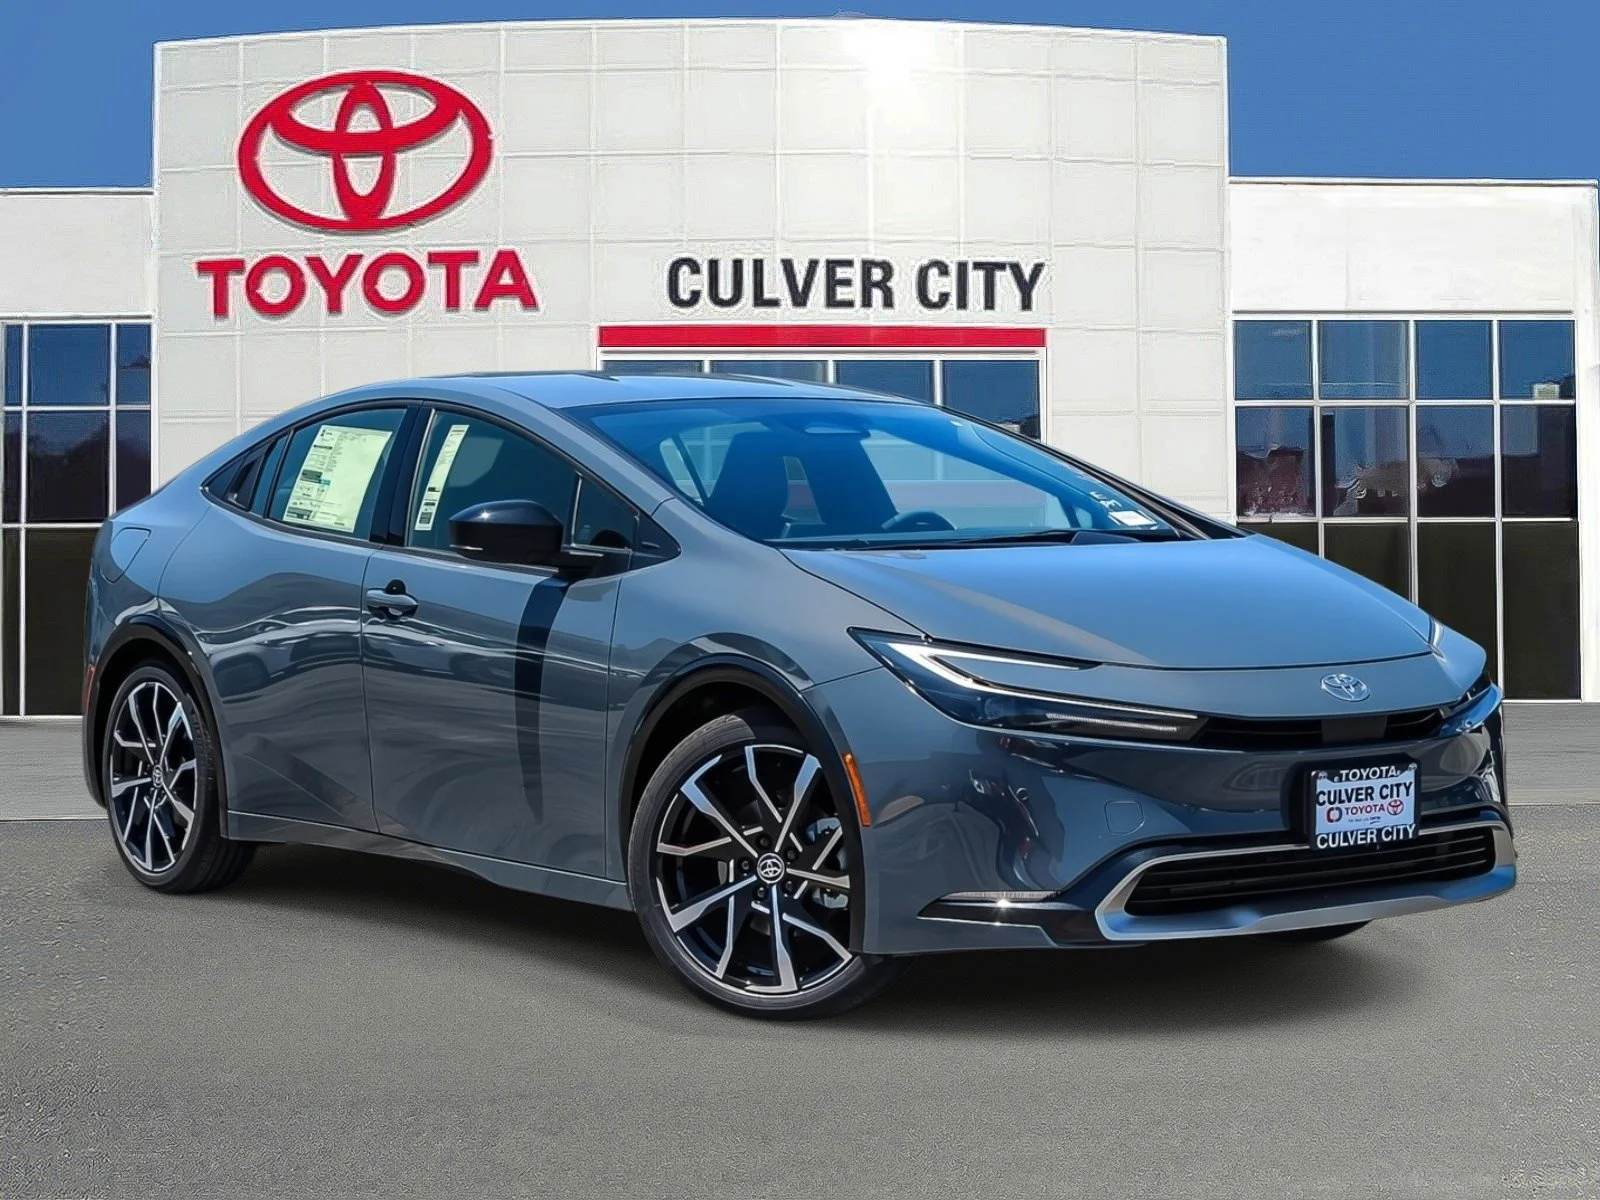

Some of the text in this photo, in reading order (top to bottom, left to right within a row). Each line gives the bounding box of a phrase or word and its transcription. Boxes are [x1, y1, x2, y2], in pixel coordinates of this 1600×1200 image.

[197, 249, 538, 319] TOYOTA
[668, 257, 1045, 311] CULVER CITY
[1340, 766, 1396, 782] TOYOTA
[1317, 782, 1413, 806] CULVER CITY
[1345, 804, 1385, 816] TOYOTA
[1317, 824, 1416, 849] CULVER CITY
